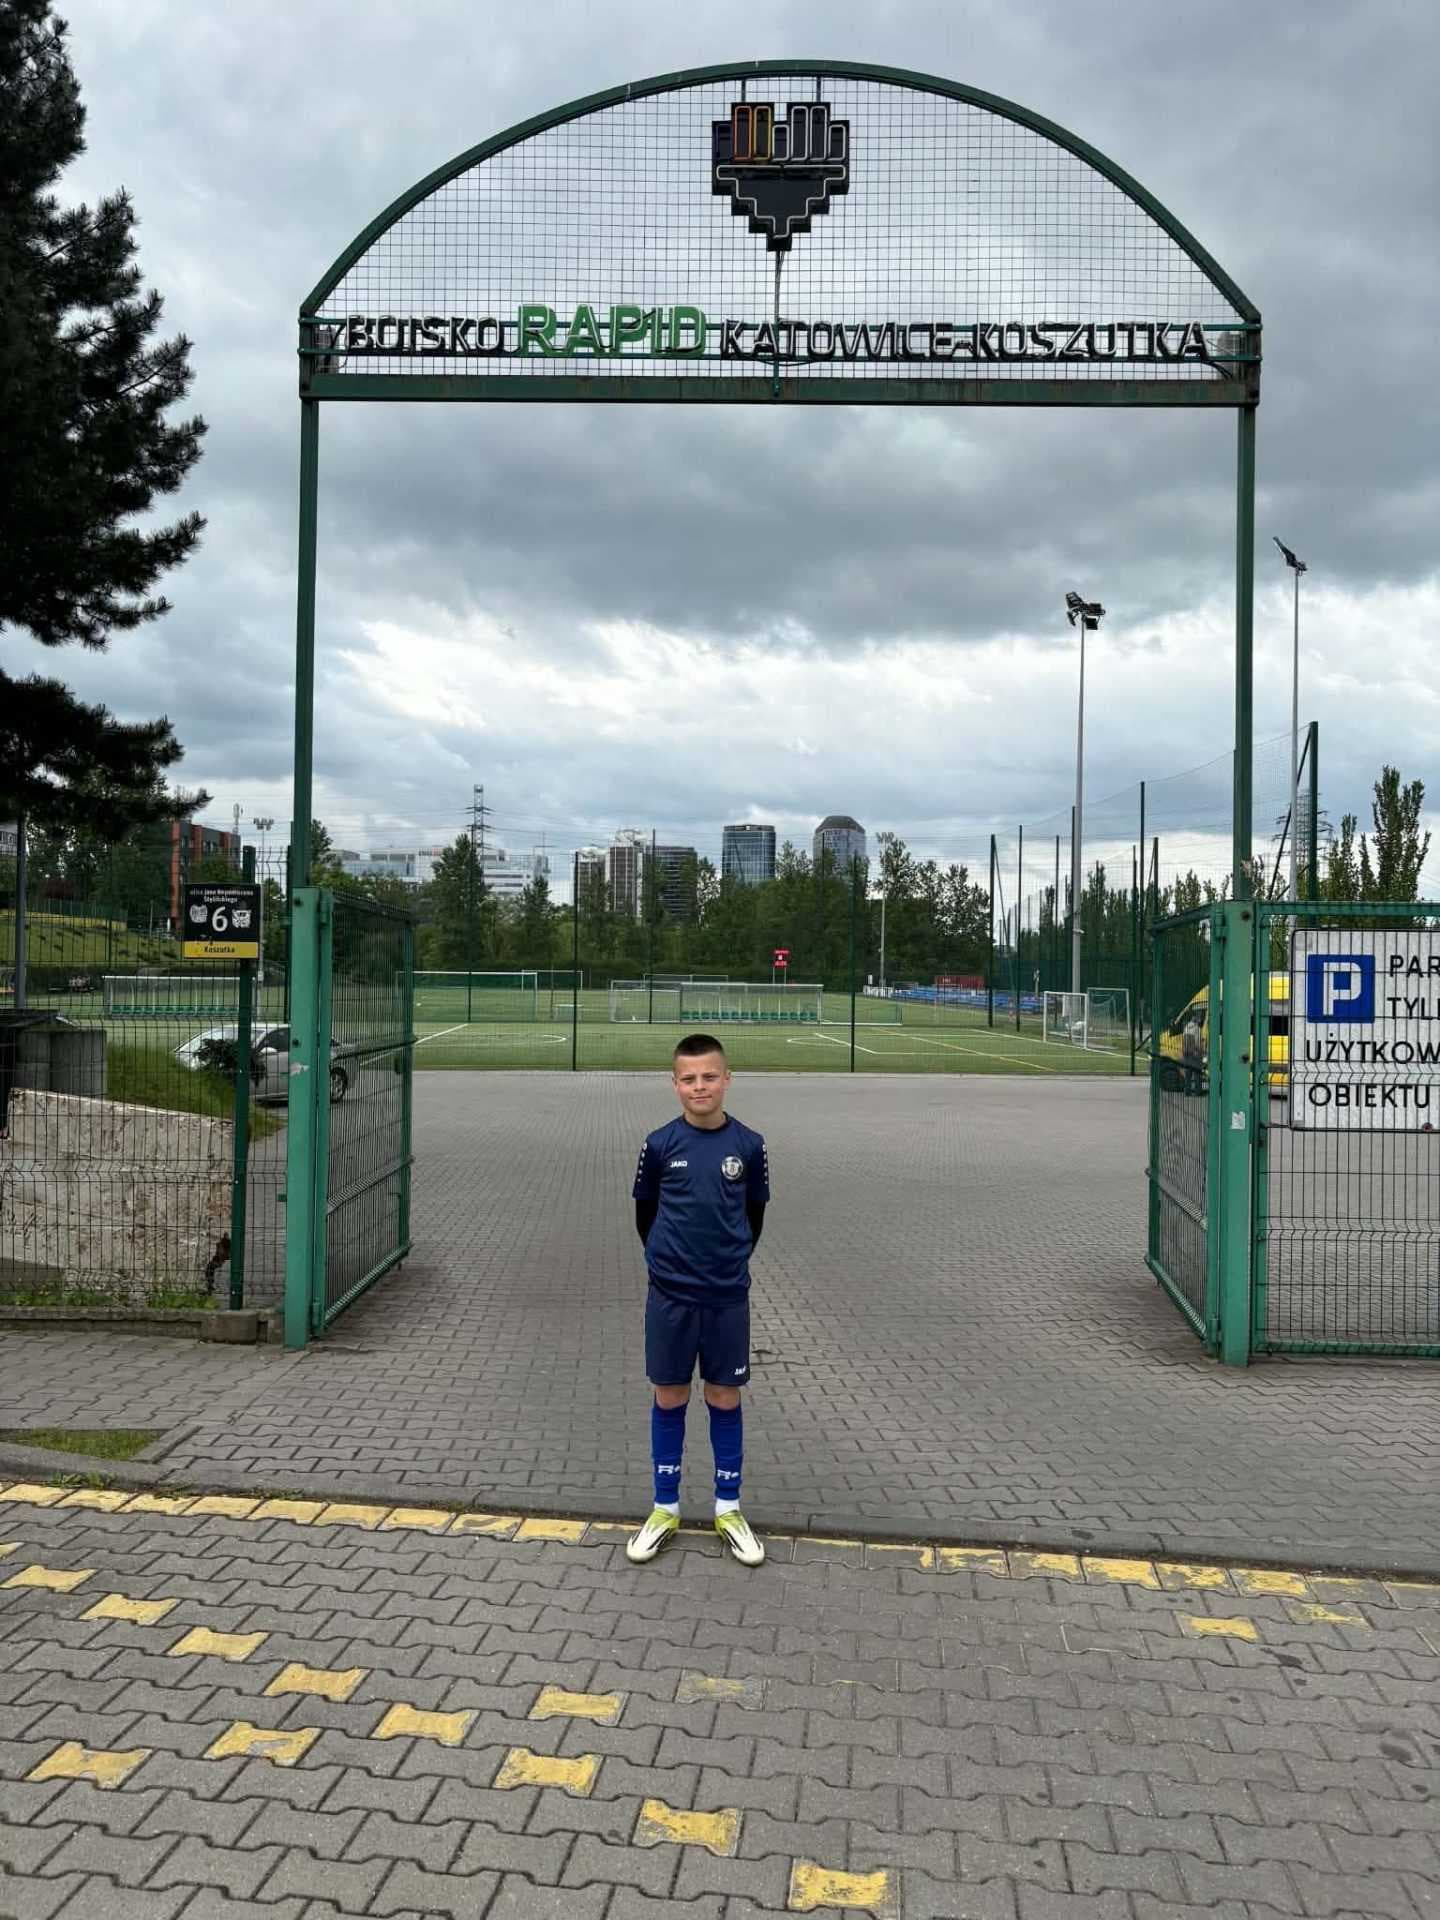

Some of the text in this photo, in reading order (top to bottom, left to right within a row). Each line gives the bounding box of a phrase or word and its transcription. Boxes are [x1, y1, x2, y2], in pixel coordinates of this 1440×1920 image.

[346, 315, 504, 354] BOISKO
[517, 303, 707, 358] RAPID
[212, 906, 228, 932] 6
[1323, 961, 1362, 1016] P
[1308, 1083, 1430, 1108] OBIEKTU
[670, 1160, 688, 1168] JAKO
